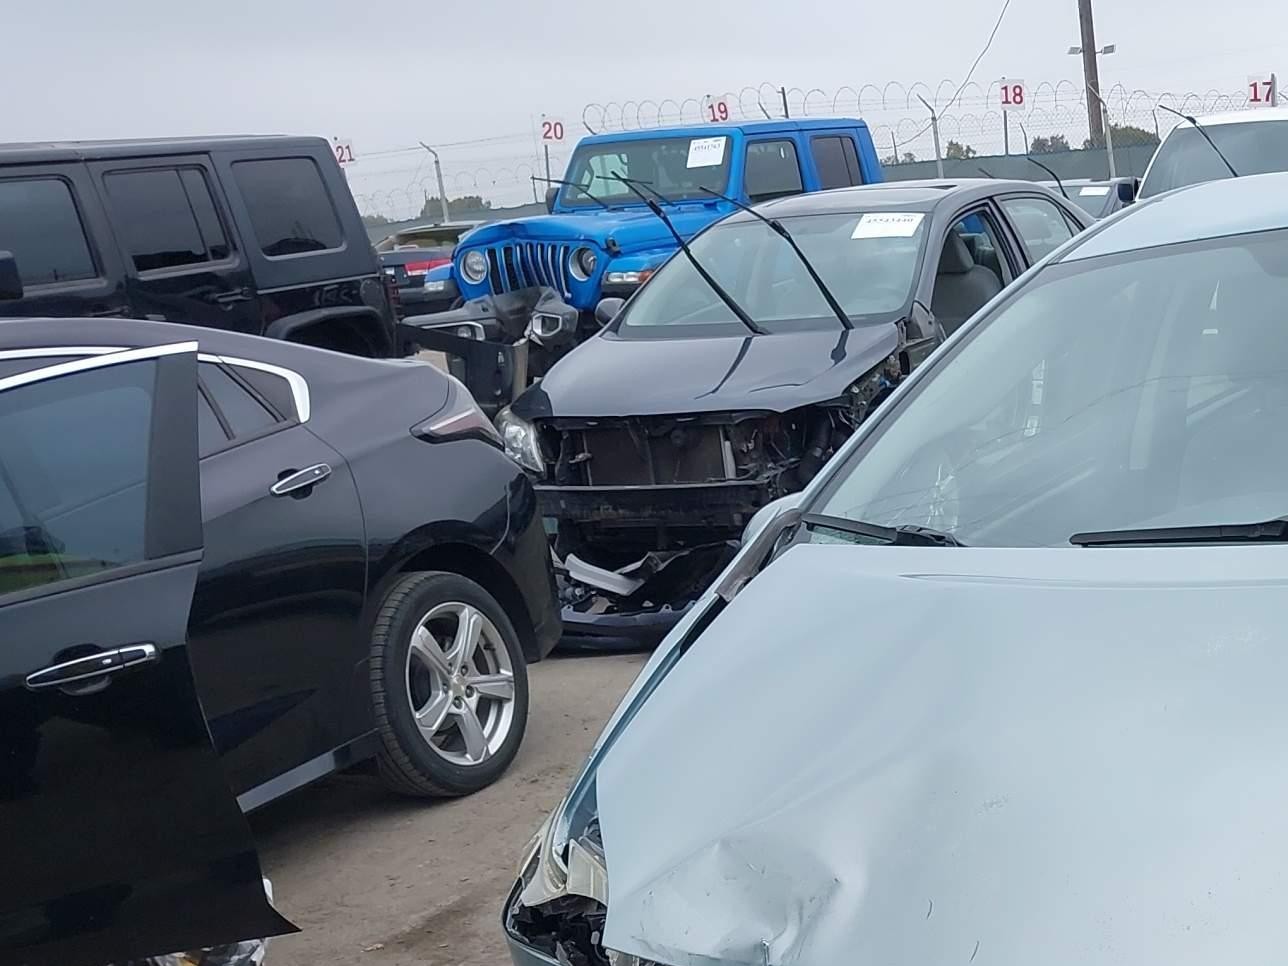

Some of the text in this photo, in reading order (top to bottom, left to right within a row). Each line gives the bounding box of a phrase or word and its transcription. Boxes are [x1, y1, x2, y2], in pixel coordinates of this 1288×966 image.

[1001, 84, 1024, 105] 18
[1249, 81, 1272, 102] 17
[707, 101, 729, 123] 19
[542, 121, 564, 140] 20
[336, 144, 355, 163] 21
